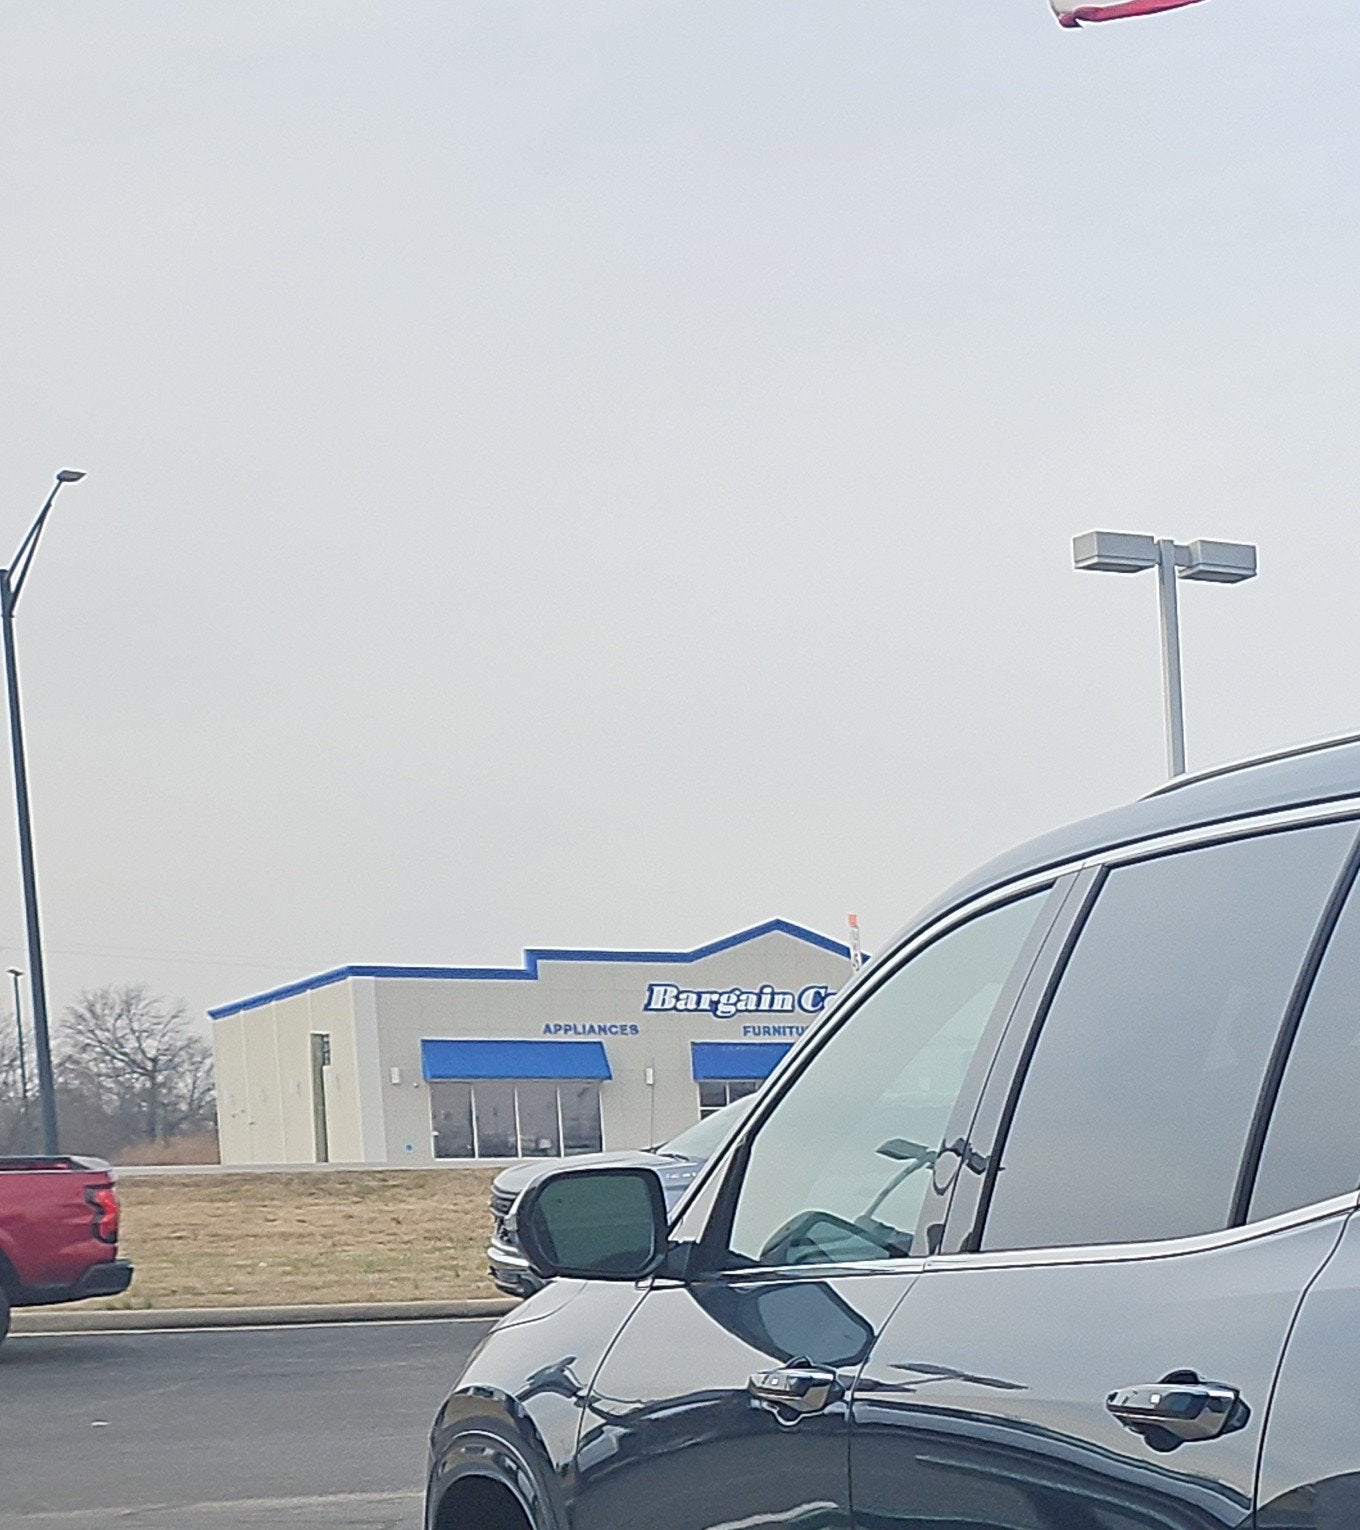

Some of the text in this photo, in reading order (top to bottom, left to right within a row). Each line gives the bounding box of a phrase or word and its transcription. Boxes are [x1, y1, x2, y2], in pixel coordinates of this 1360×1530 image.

[644, 983, 795, 1018] Bargain
[543, 1023, 640, 1036] APPLIANCES
[742, 1025, 809, 1037] FURNITU
